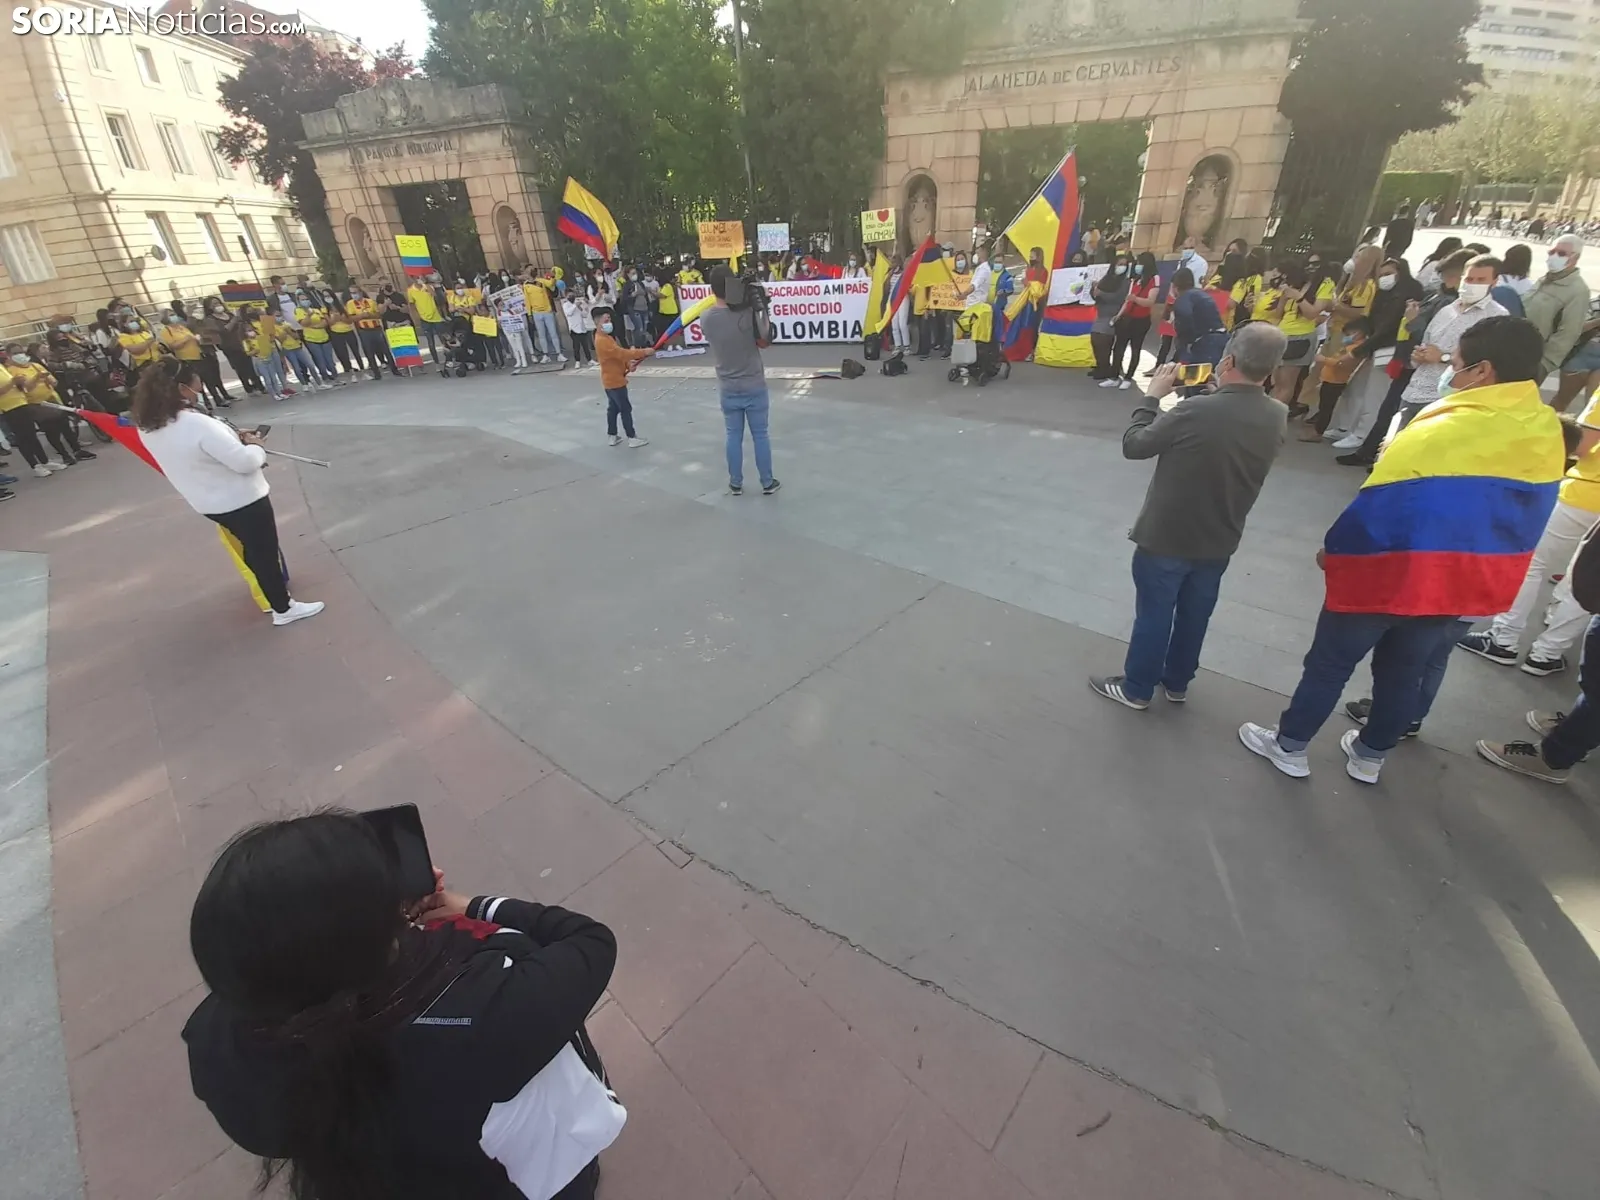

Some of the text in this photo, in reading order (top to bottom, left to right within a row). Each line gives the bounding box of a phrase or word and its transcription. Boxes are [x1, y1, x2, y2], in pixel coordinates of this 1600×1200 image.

[968, 56, 1182, 92] ALAMEDA DE CERVANTES
[768, 285, 820, 298] SACRANDO
[824, 284, 831, 296] A
[832, 284, 844, 295] MI
[845, 280, 869, 295] PAÍS
[773, 302, 842, 316] GENOCIDIO
